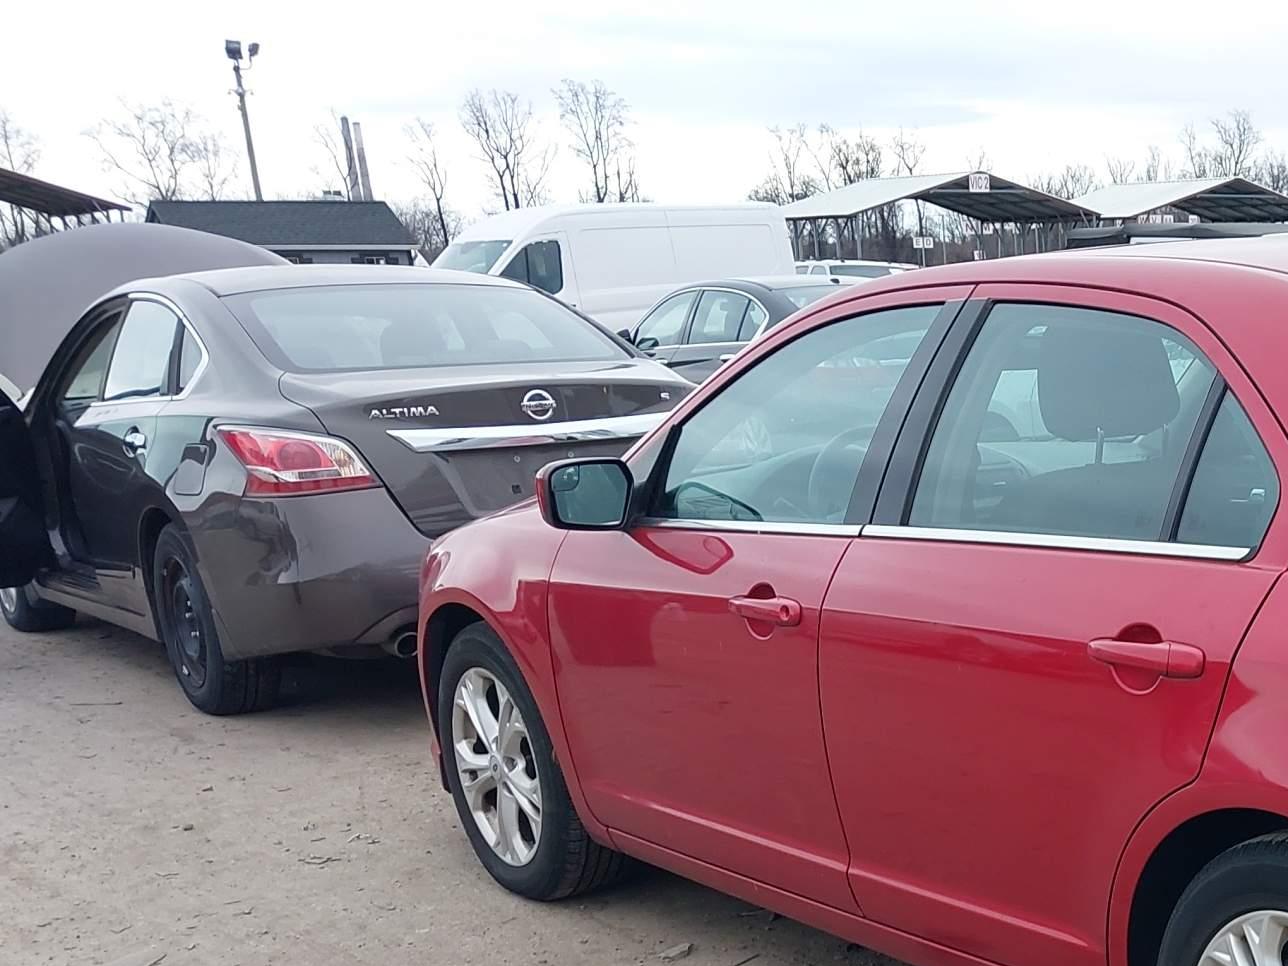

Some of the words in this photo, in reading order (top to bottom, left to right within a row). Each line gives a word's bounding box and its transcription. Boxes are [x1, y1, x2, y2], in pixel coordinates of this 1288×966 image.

[969, 175, 983, 190] VIC
[984, 175, 989, 190] 2
[368, 405, 440, 420] ALTIMA
